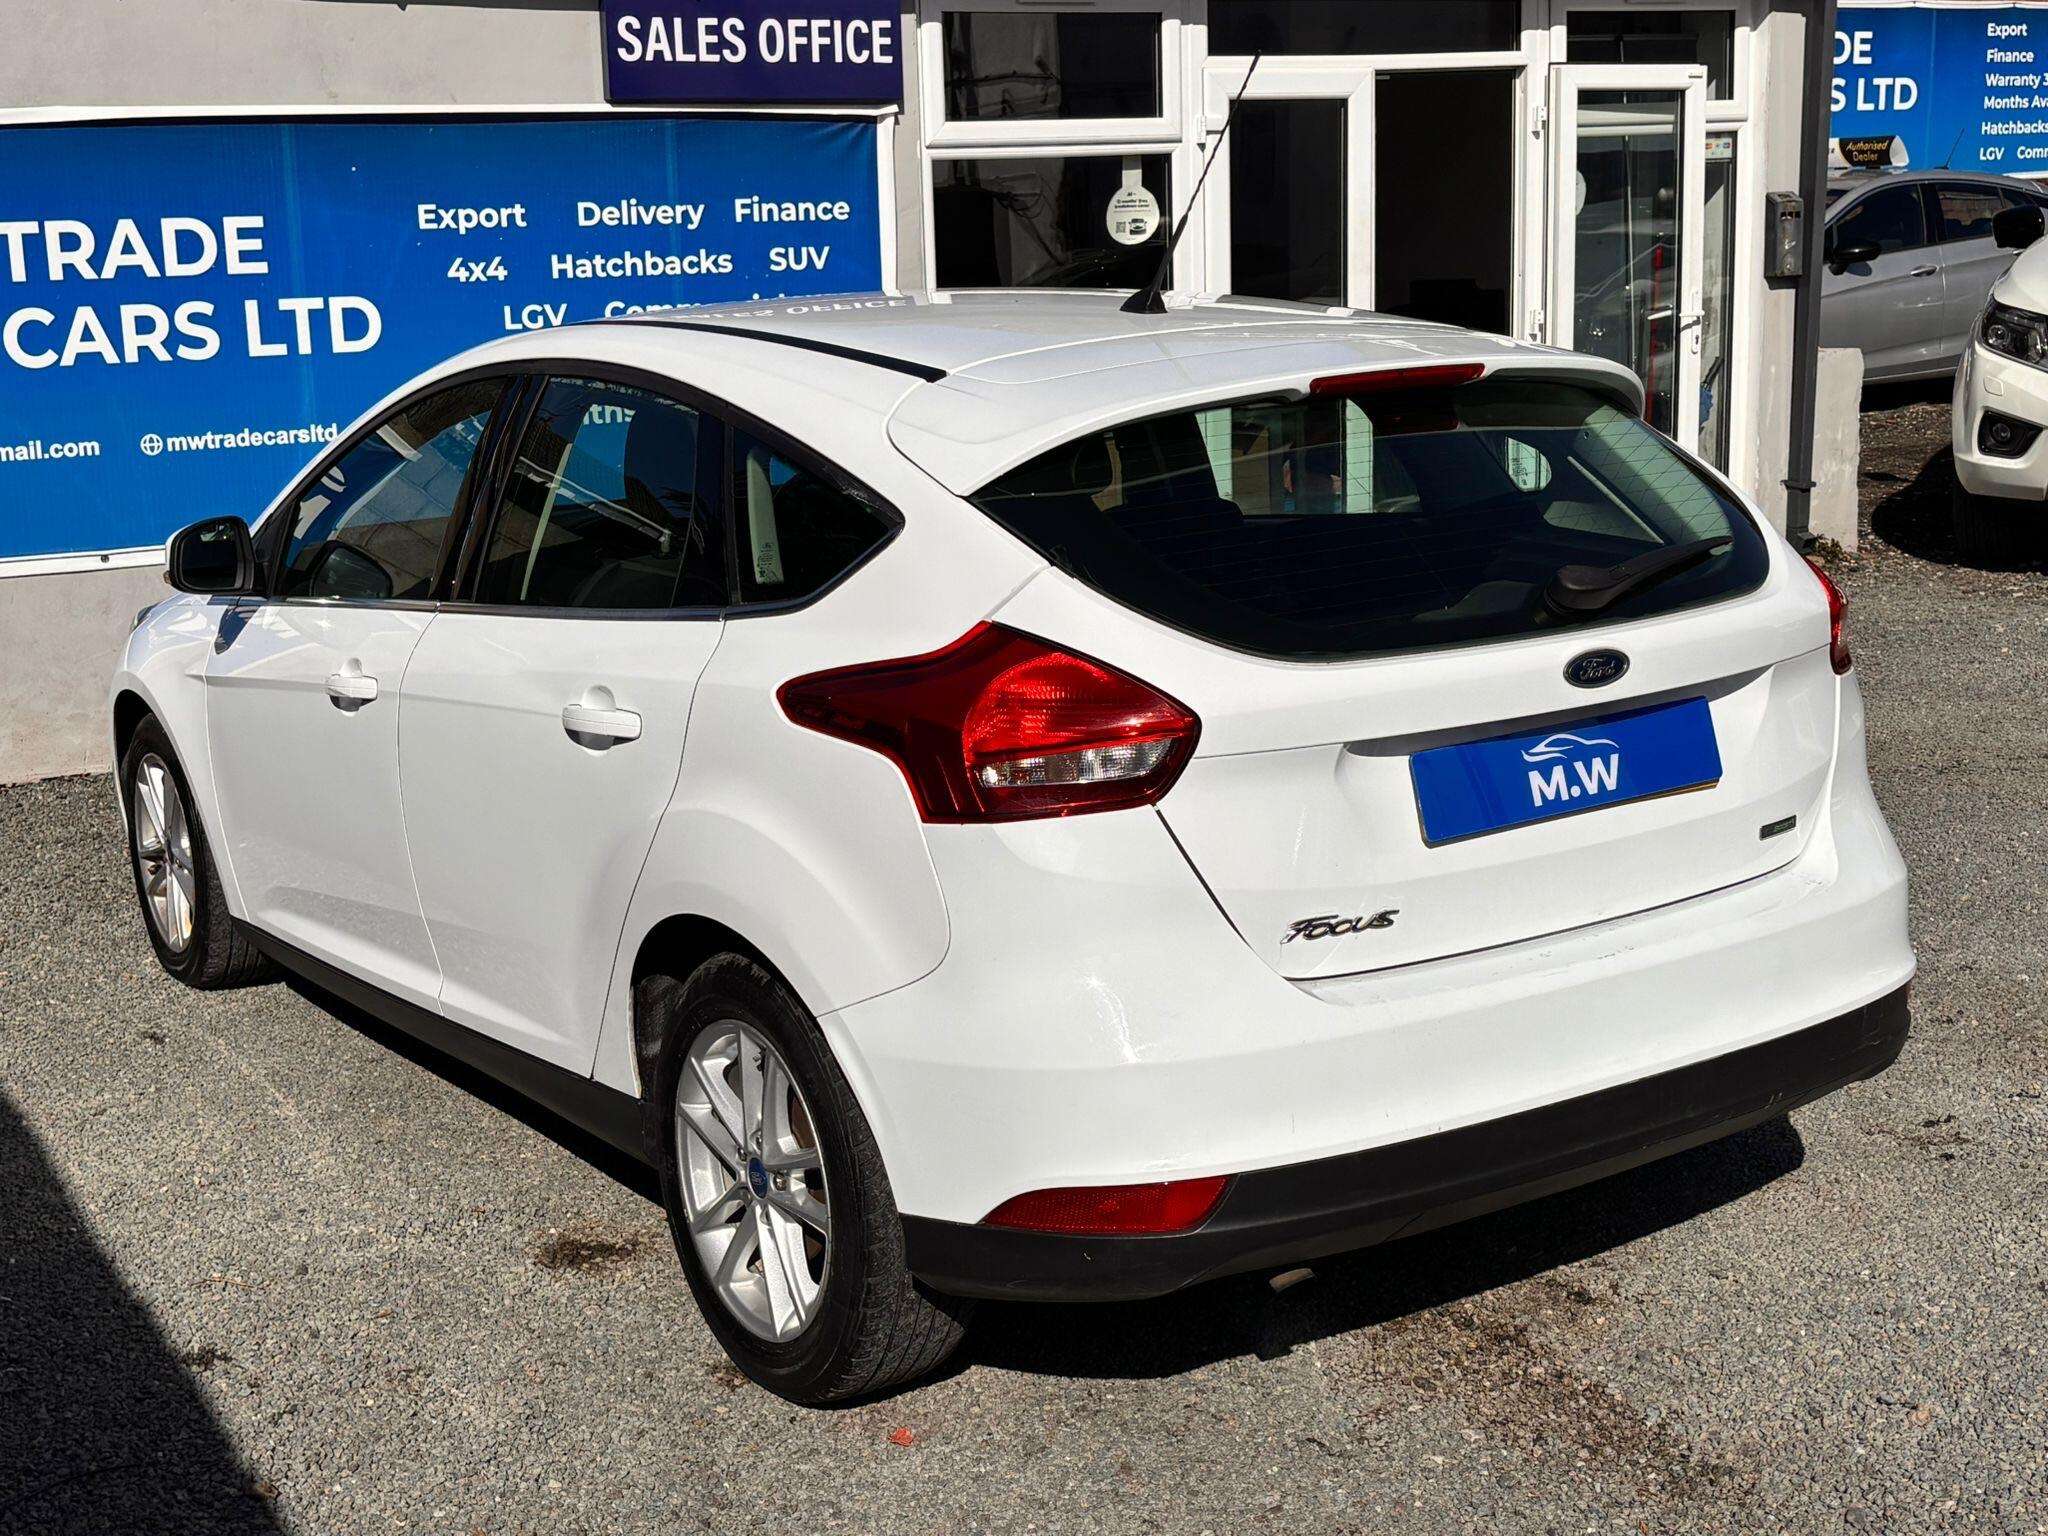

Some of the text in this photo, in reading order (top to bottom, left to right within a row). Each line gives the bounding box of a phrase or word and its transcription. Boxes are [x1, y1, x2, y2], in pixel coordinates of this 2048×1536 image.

[616, 15, 893, 64] SALES OFFICE
[1986, 22, 2028, 39] Export
[1986, 47, 2035, 63] Finance
[1857, 77, 1919, 112] LTD
[1985, 72, 2041, 89] Warranty
[1983, 94, 2029, 109] Months
[1846, 140, 1888, 152] Authorised
[1852, 150, 1878, 162] Dealer
[1979, 146, 2005, 161] LGV
[417, 196, 851, 234] Export Delivery Finance
[0, 215, 269, 283] TRADE
[446, 246, 830, 283] 4x4 Hatchbacks SUV
[503, 302, 568, 330] LGV
[2, 296, 383, 369] CARS LTD
[166, 423, 338, 452] mwtradecarsltd
[1528, 753, 1619, 808] M.W
